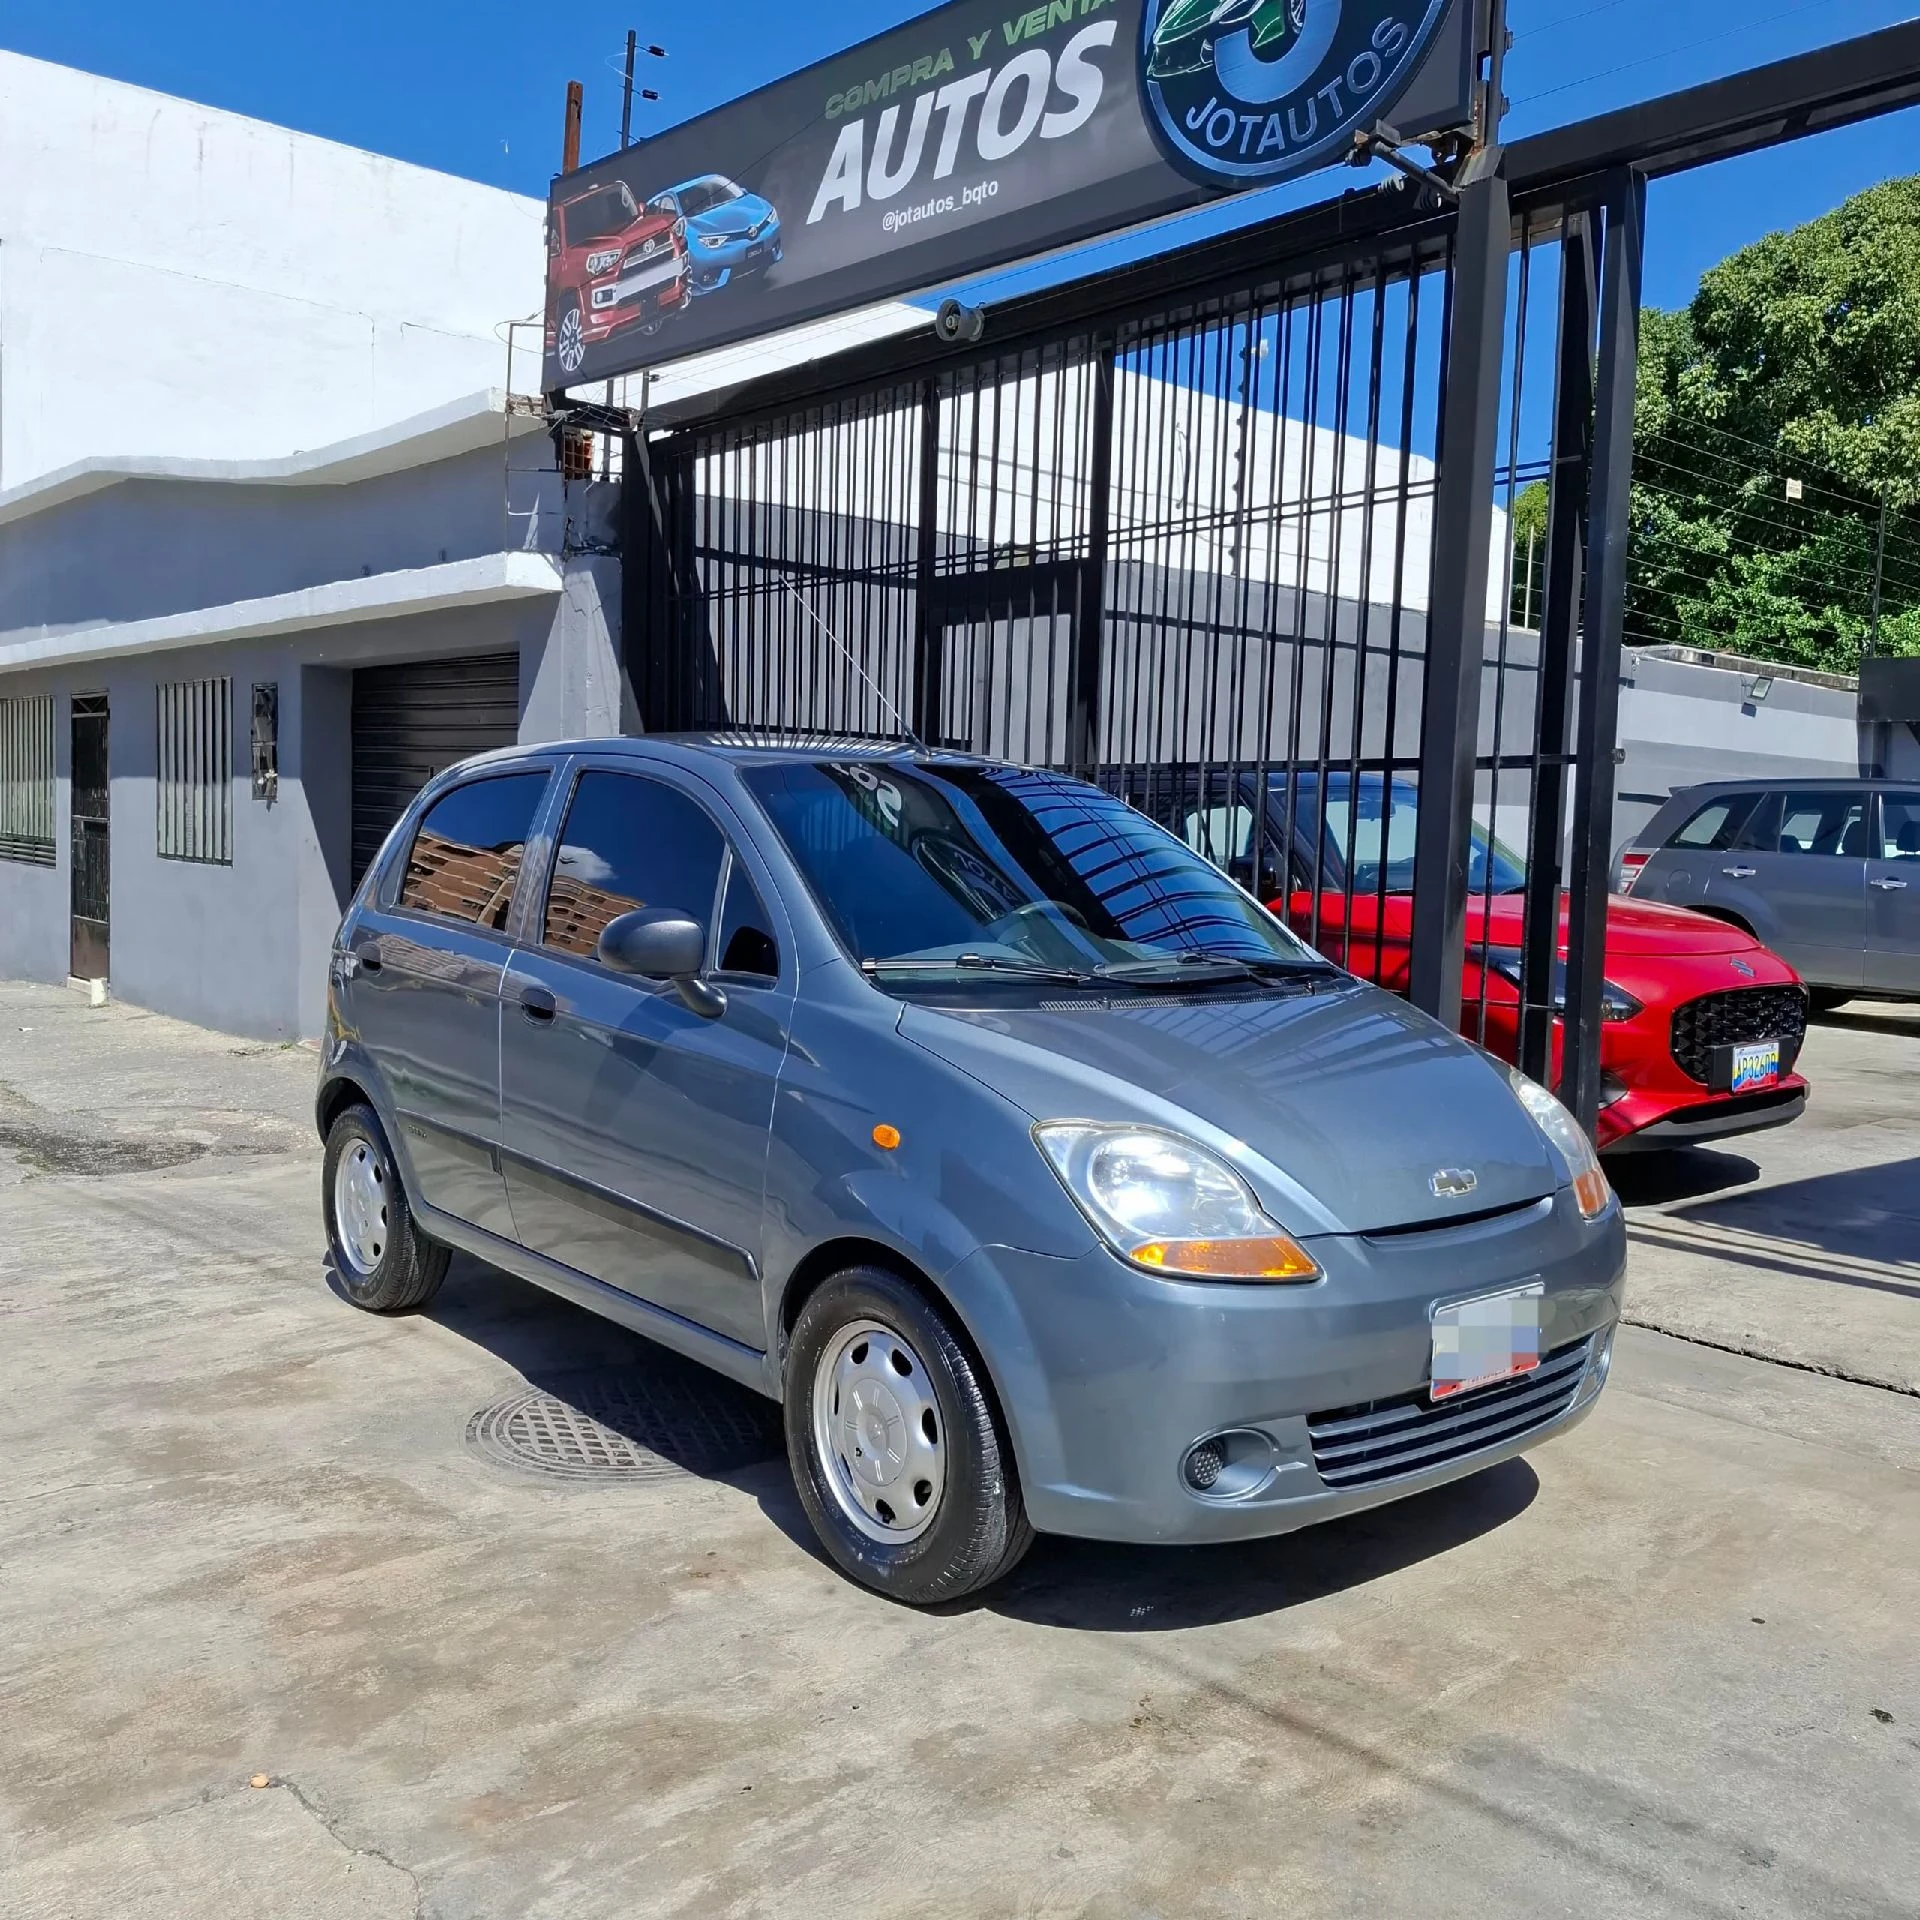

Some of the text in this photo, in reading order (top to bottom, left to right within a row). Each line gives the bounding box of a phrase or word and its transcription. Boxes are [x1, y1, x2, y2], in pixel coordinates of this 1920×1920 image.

[806, 20, 1118, 224] AUTOS
[825, 0, 1115, 120] COMPRA Y VENT
[1186, 17, 1408, 155] JOTAUTOS
[882, 181, 998, 233] @jotautos_bqto
